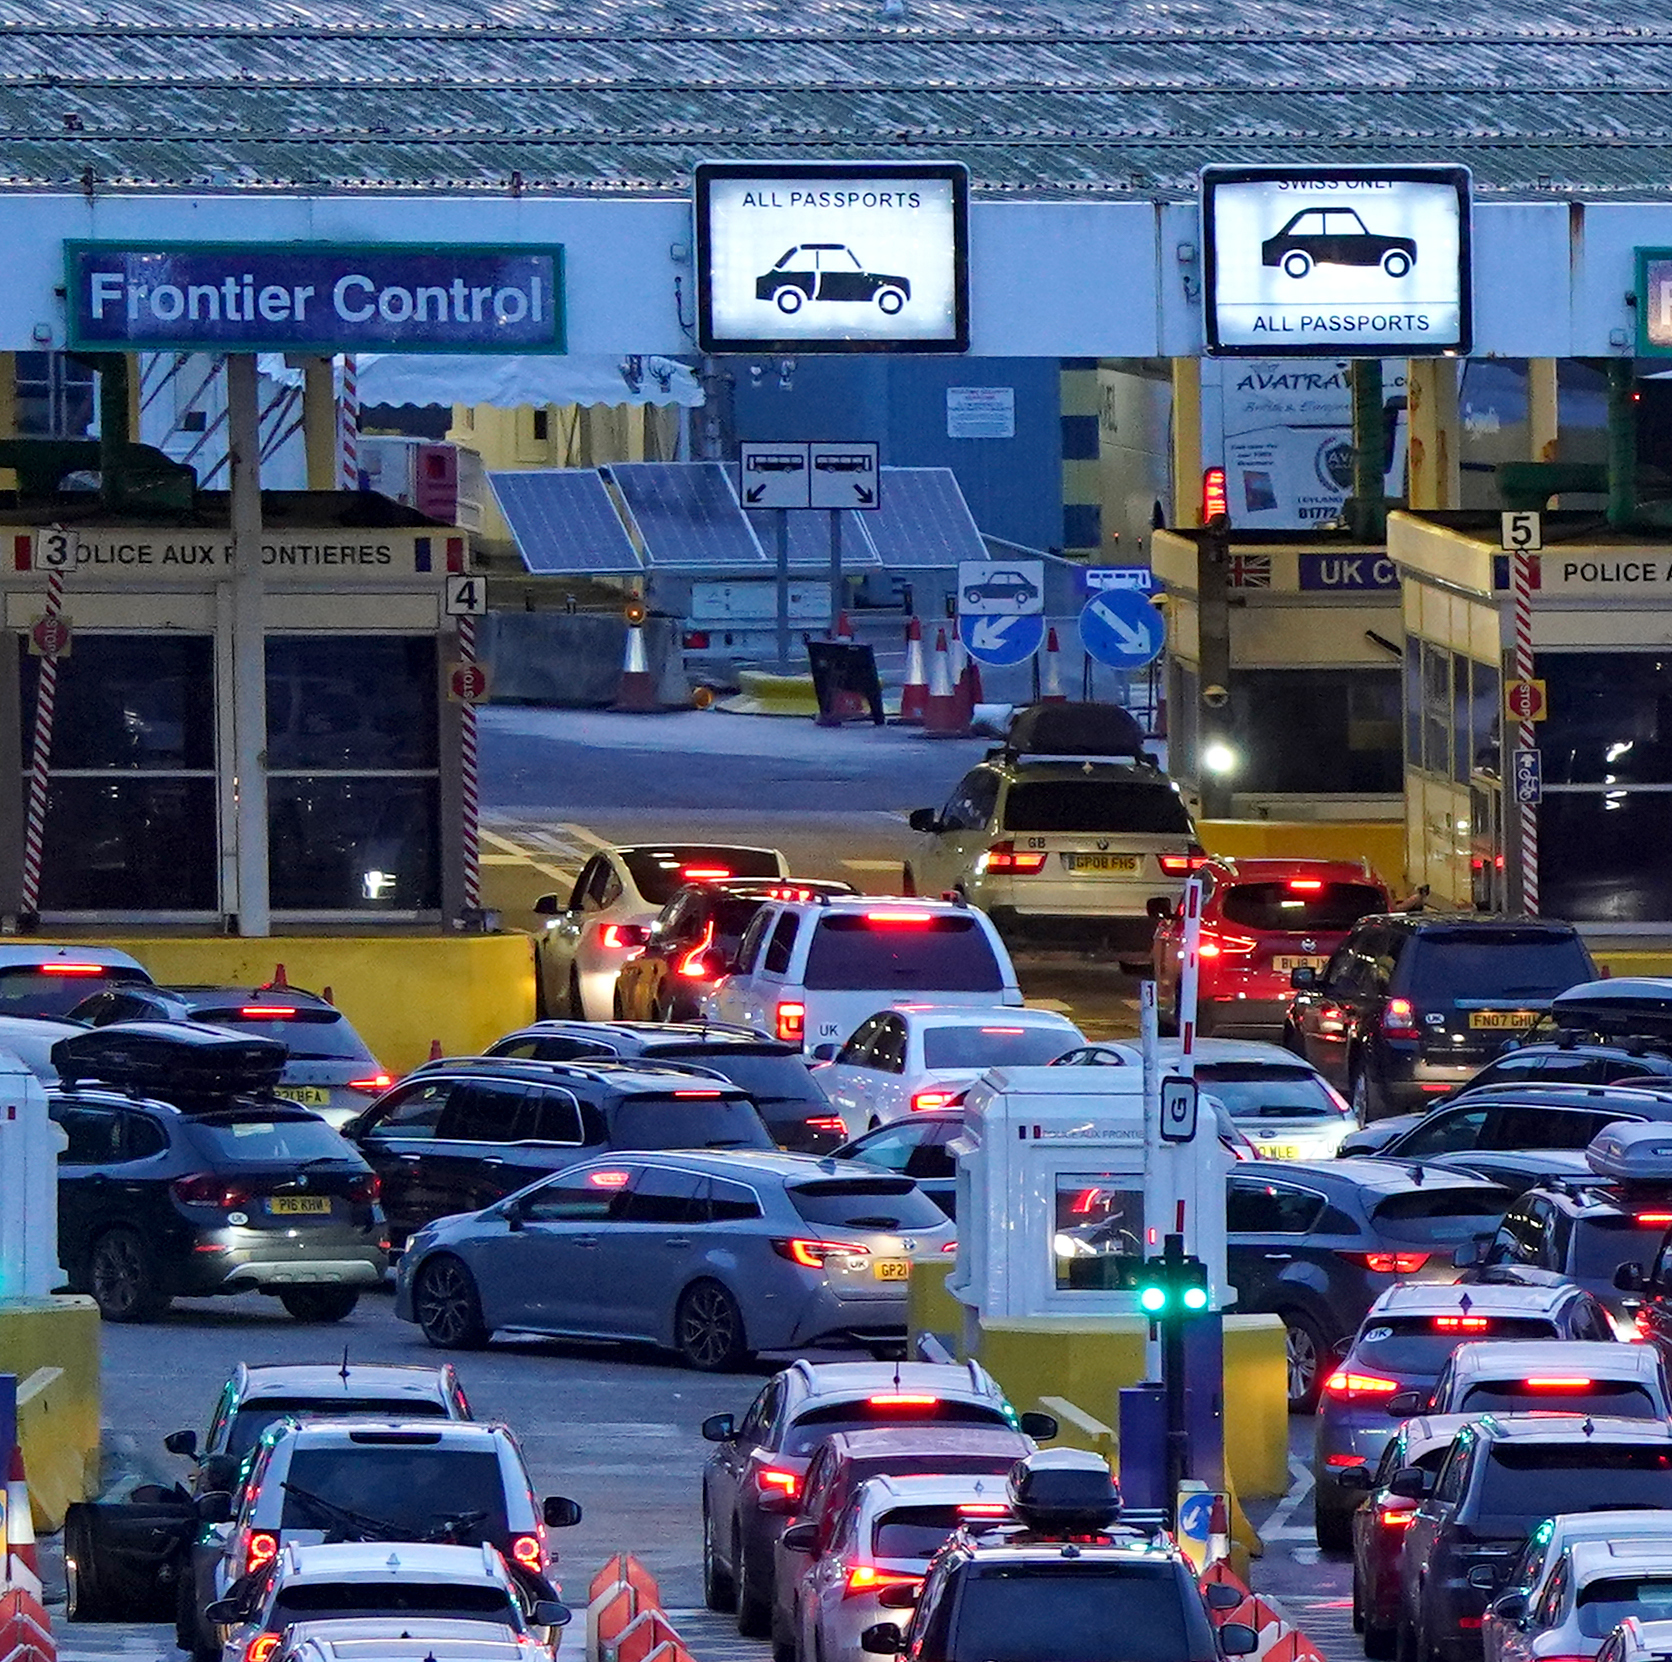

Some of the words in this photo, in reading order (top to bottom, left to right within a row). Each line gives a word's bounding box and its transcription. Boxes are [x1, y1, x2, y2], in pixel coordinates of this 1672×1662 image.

[741, 192, 783, 208] ALL
[790, 191, 921, 208] PASSPORTS
[91, 274, 315, 323] Frontier
[333, 271, 544, 324] Control
[1253, 316, 1293, 332] ALL
[1301, 315, 1430, 332] PASSPORTS
[1511, 516, 1532, 545] 5
[47, 535, 68, 566] 3
[75, 545, 153, 565] OLICE
[162, 545, 215, 565] AUX
[224, 545, 391, 565] FONTIERES
[1320, 560, 1363, 584] UK
[1564, 563, 1656, 582] POLICE
[455, 581, 477, 610] 4
[463, 670, 475, 699] STOP
[1520, 683, 1532, 719] STOP
[1028, 837, 1046, 849] GB
[820, 1024, 839, 1036] UK
[1474, 1014, 1507, 1028] FN07
[1171, 1097, 1187, 1122] G
[850, 1260, 865, 1269] UK
[1369, 1327, 1387, 1339] UK
